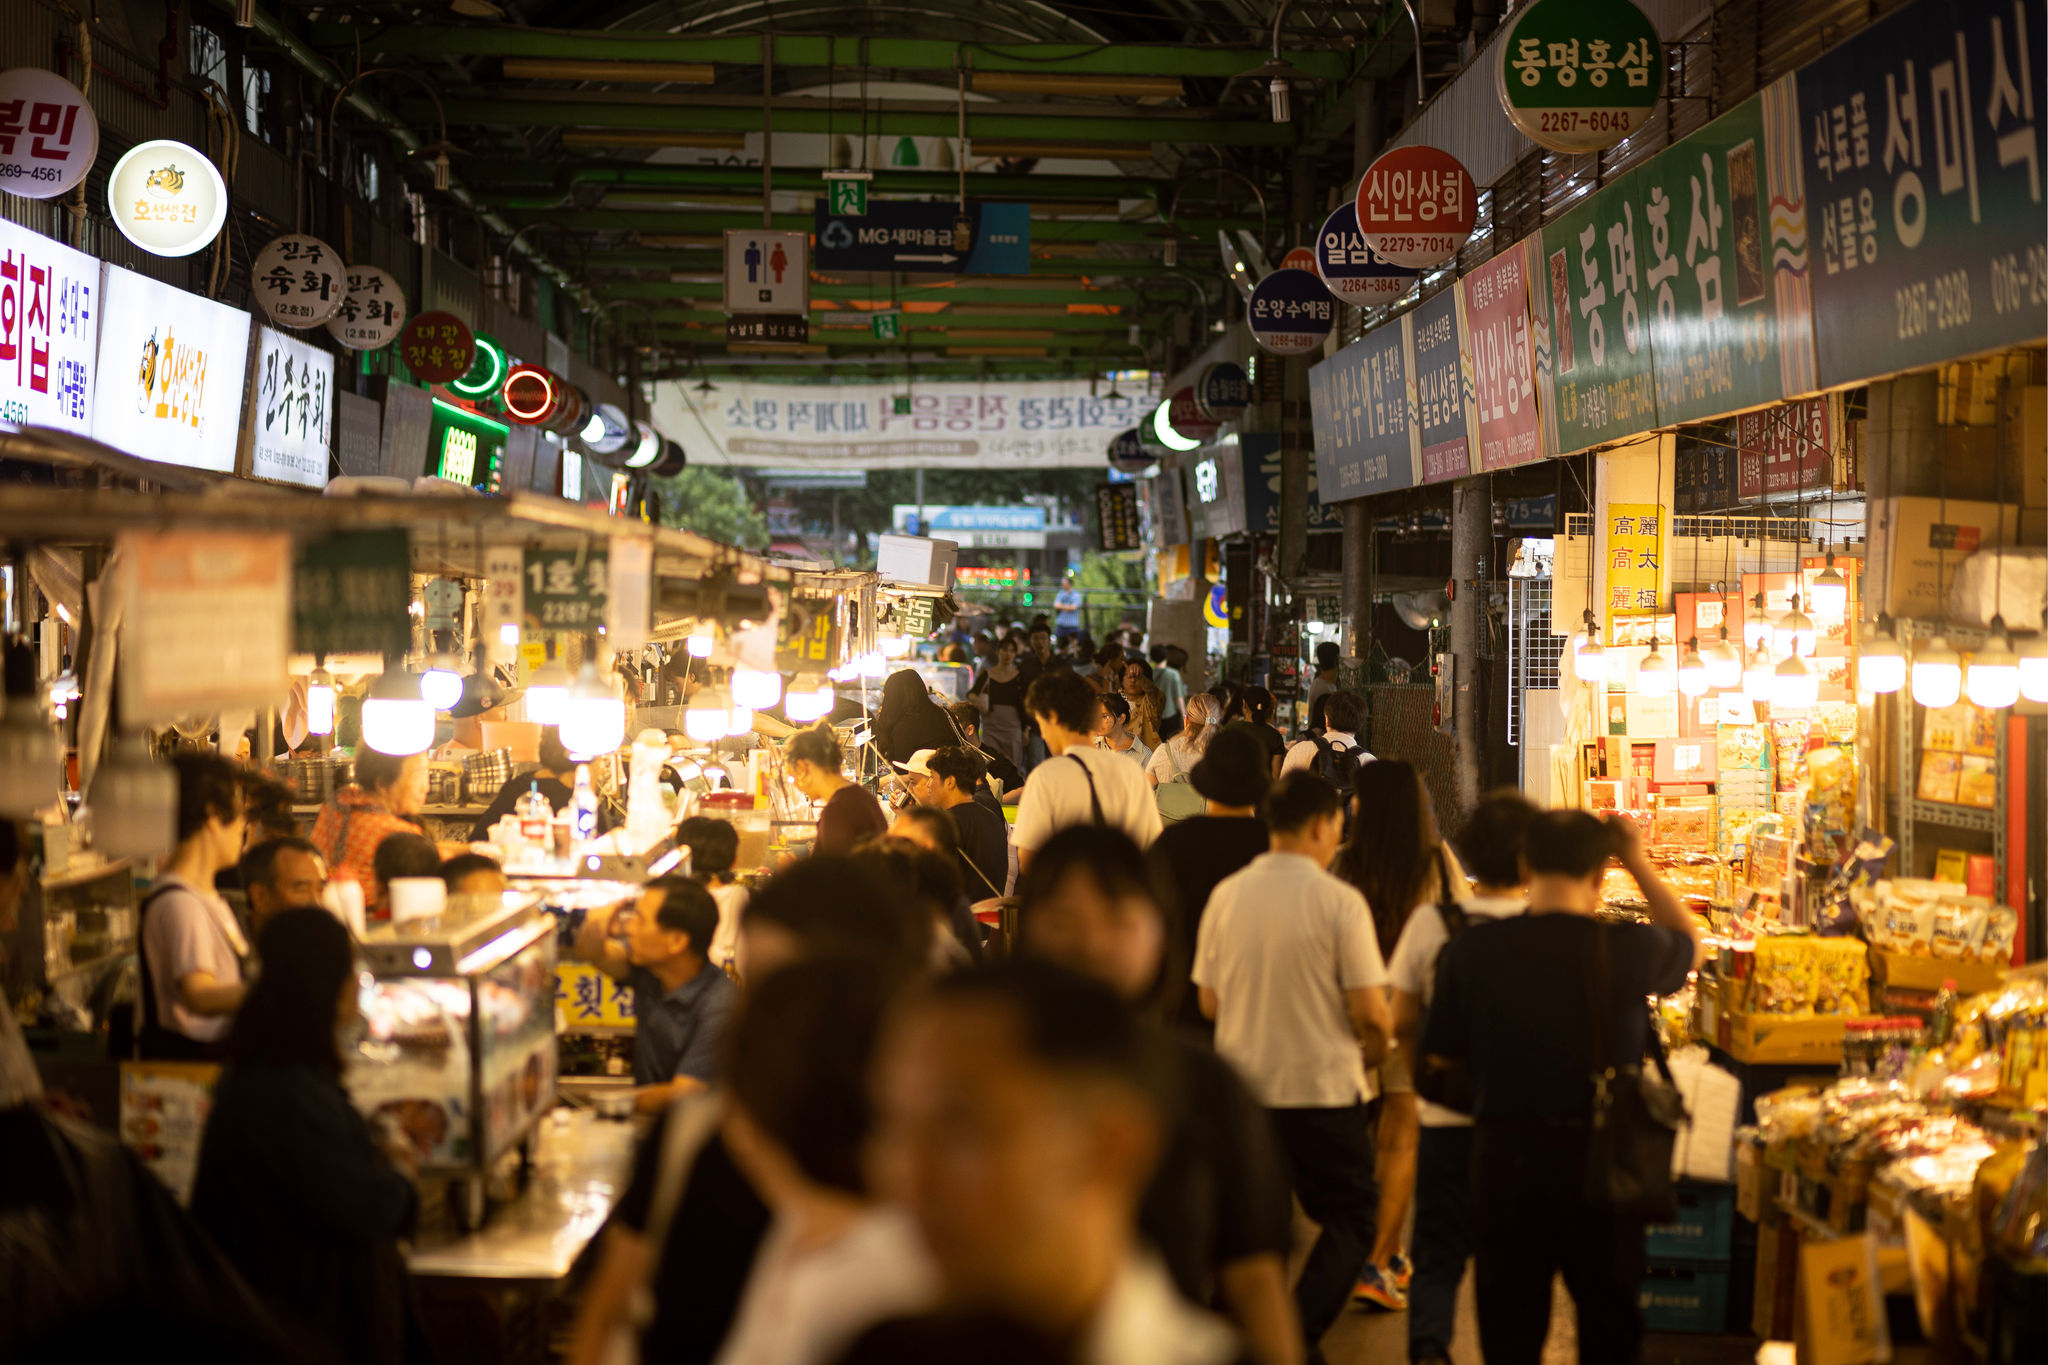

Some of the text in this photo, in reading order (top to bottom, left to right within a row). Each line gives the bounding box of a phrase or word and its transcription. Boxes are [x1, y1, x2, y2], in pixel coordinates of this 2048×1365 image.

[1511, 37, 1654, 88] 동명홍삼
[1541, 111, 1630, 132] 2267-6043
[1814, 91, 1871, 183] 식료품
[133, 199, 197, 224] 호선생전
[1367, 169, 1463, 222] 신안상회
[858, 227, 957, 246] MG새마을금
[1379, 236, 1455, 253] 2279-7014
[1821, 186, 1878, 276] 선물용
[276, 241, 324, 264] 진주
[1579, 152, 1723, 366] 동명홍삼
[260, 265, 333, 302] 육회
[347, 274, 384, 294] 진주
[1342, 279, 1401, 293] 2264-3845
[60, 276, 90, 341] 생대구
[274, 303, 316, 318] (2호점)
[1253, 298, 1331, 320] 온양수예점
[416, 323, 460, 342] 대광
[155, 325, 208, 429] 호선생전
[1473, 314, 1532, 424] 신안상회
[263, 348, 326, 444] 진주육회
[1330, 352, 1386, 448] 온양수예점
[1420, 361, 1461, 430] 일심상회
[1614, 515, 1658, 537] 高麗
